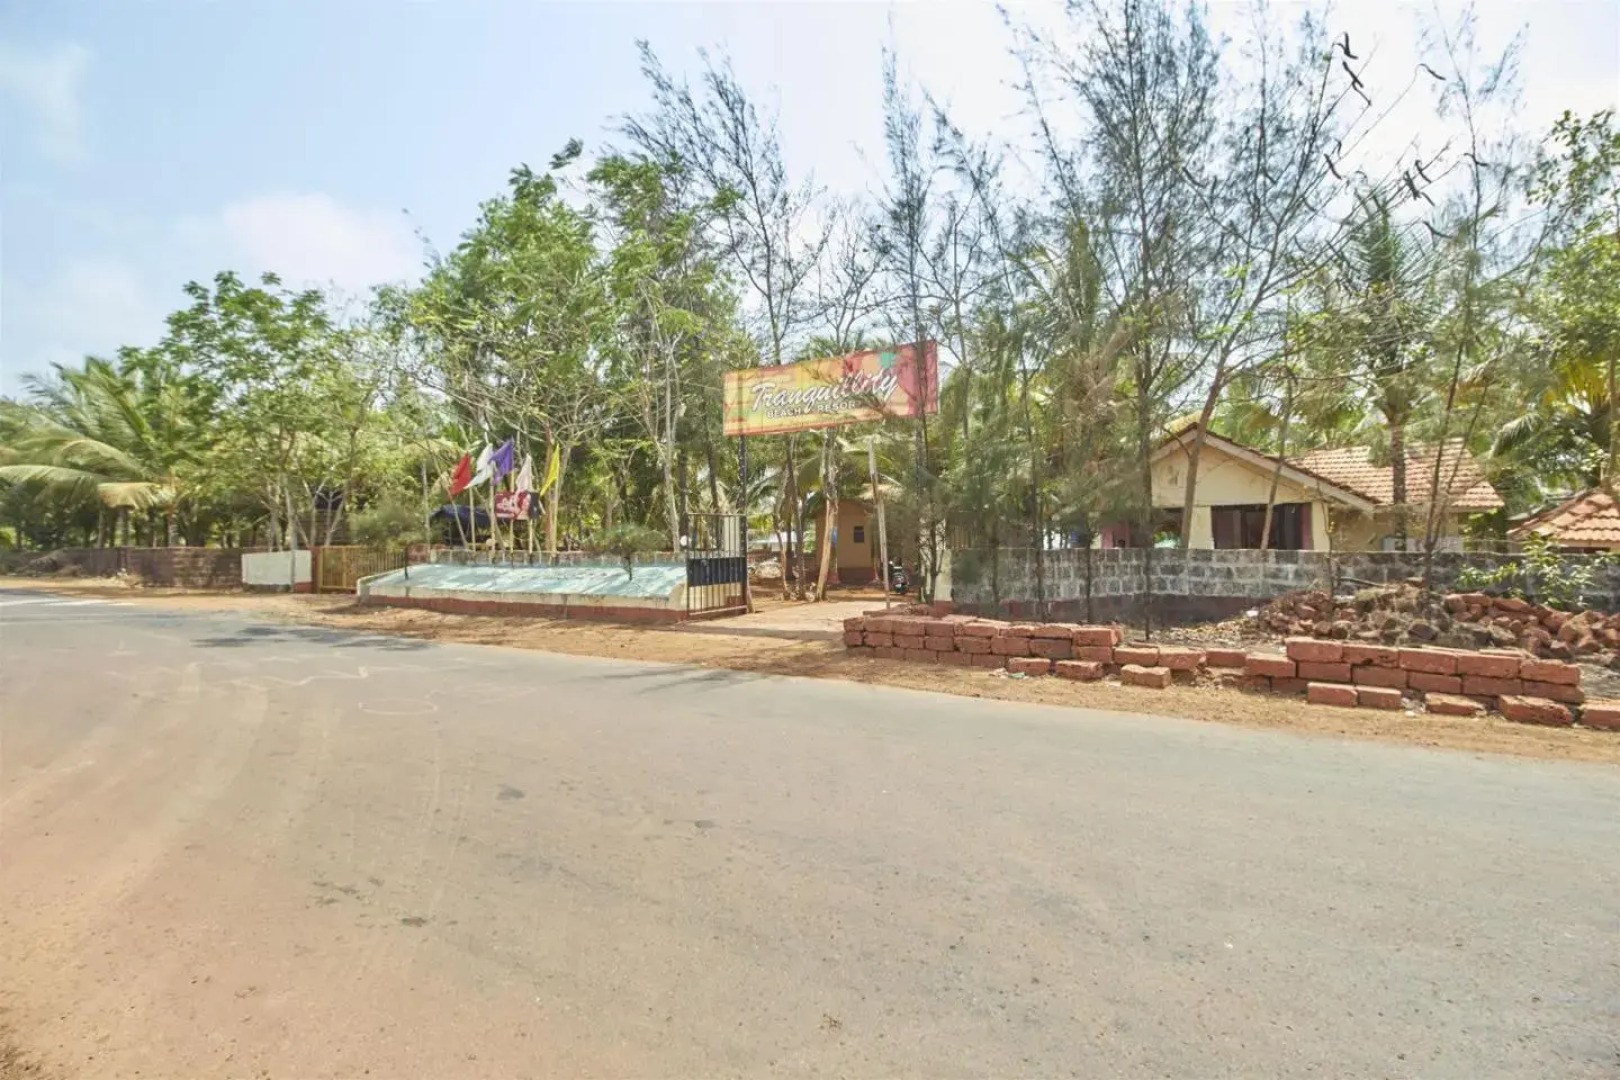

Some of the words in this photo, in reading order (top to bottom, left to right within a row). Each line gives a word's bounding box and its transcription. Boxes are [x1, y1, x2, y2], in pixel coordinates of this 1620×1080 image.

[752, 368, 898, 413] Tranquillity
[766, 408, 801, 419] BEACH
[817, 400, 862, 413] RESOR
